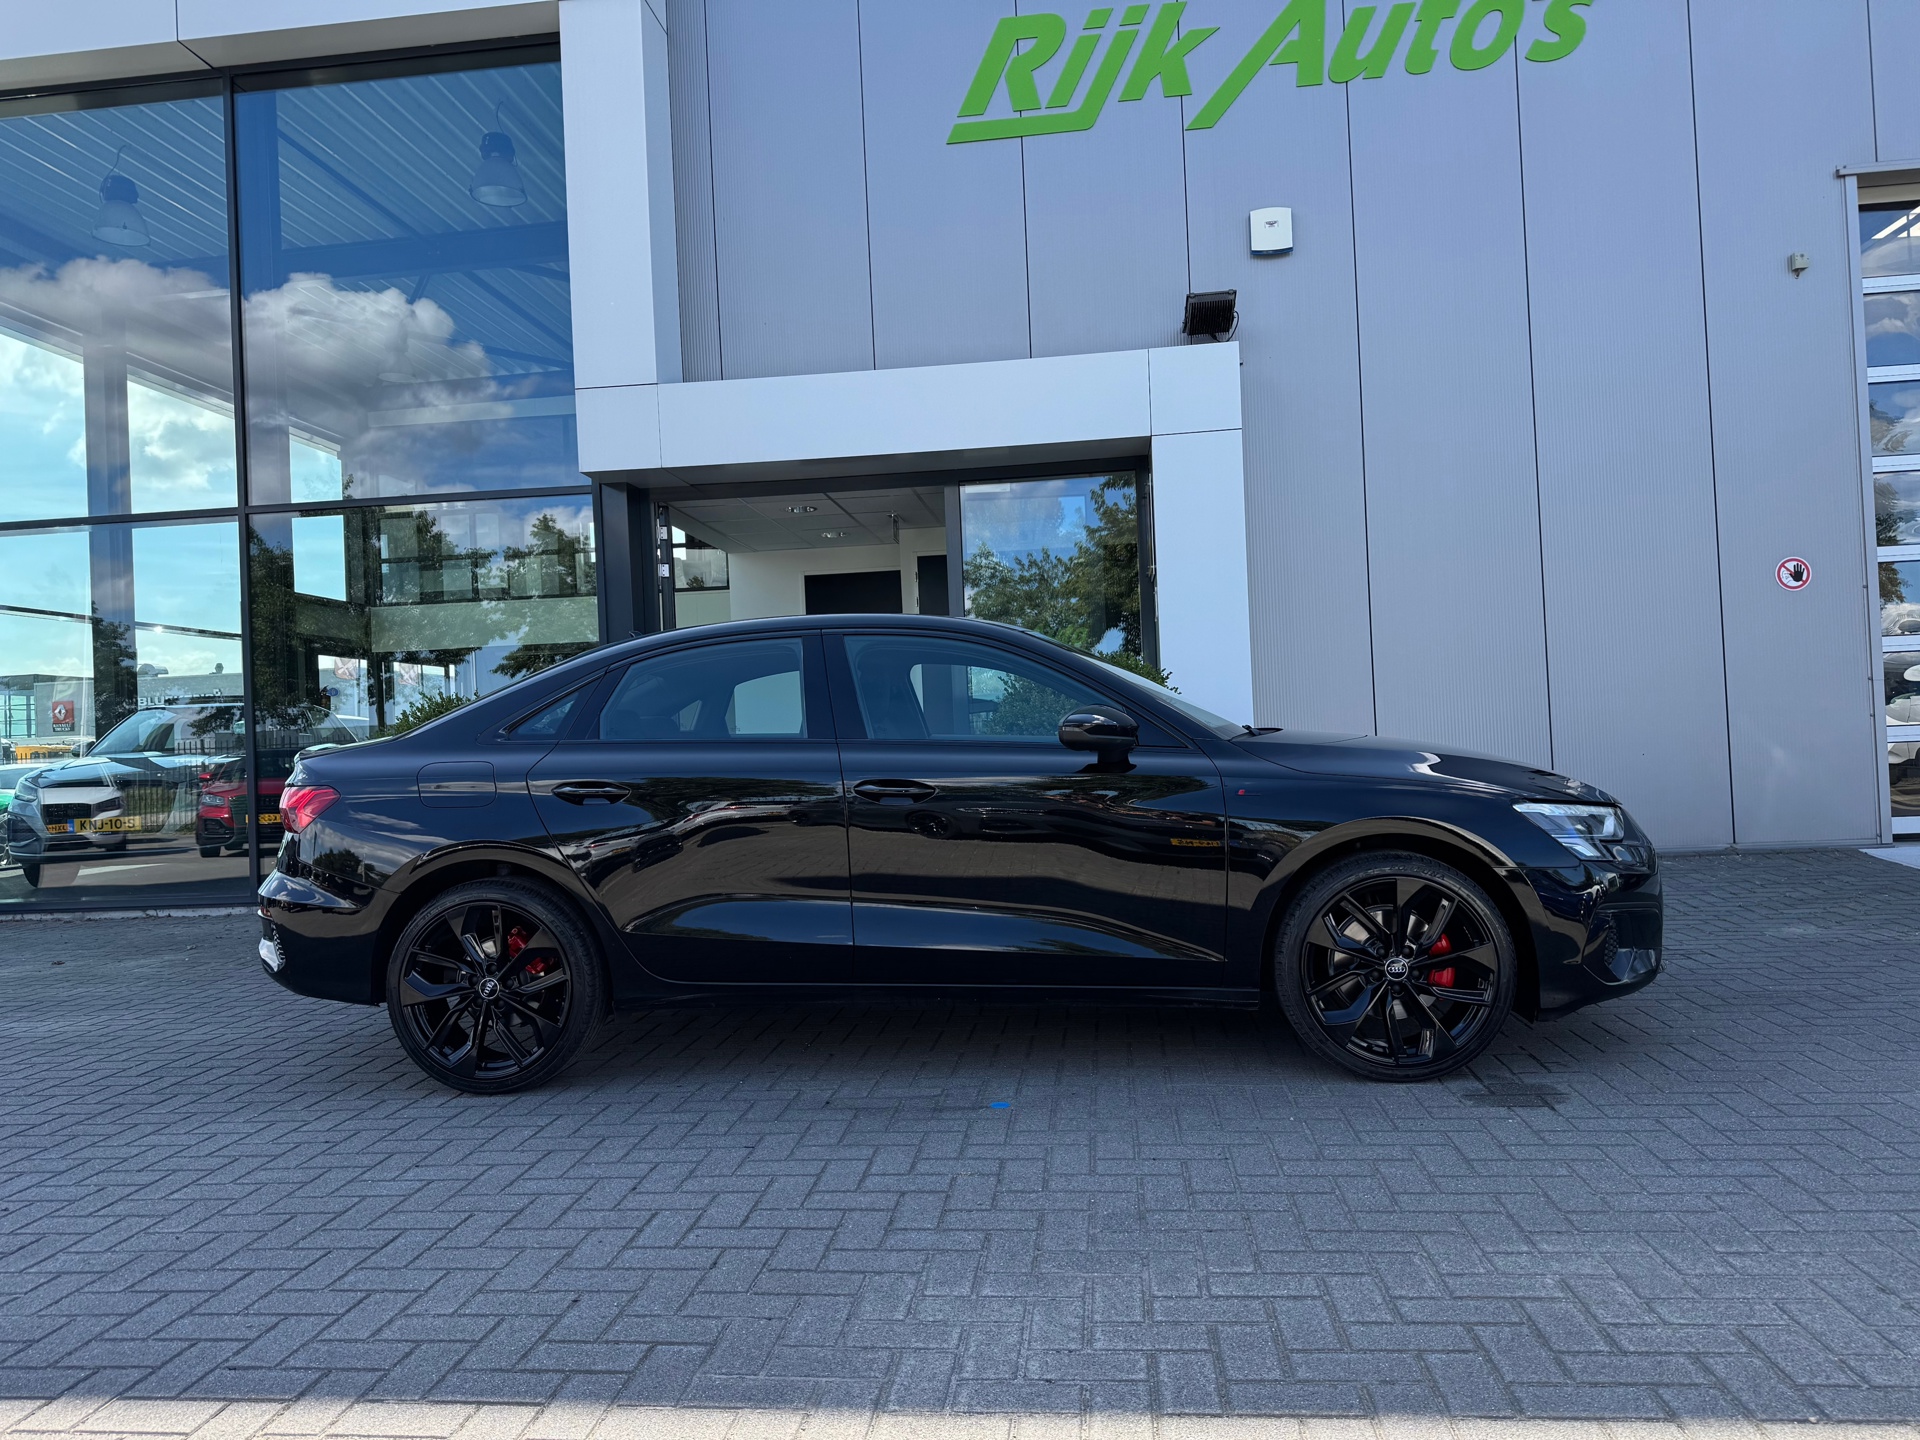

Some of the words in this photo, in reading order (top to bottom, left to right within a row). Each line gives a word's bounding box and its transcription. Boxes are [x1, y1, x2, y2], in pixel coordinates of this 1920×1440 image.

[947, 1, 1220, 144] Rijk
[1186, 0, 1593, 131] Autos
[80, 818, 136, 830] KNJ-10-S
